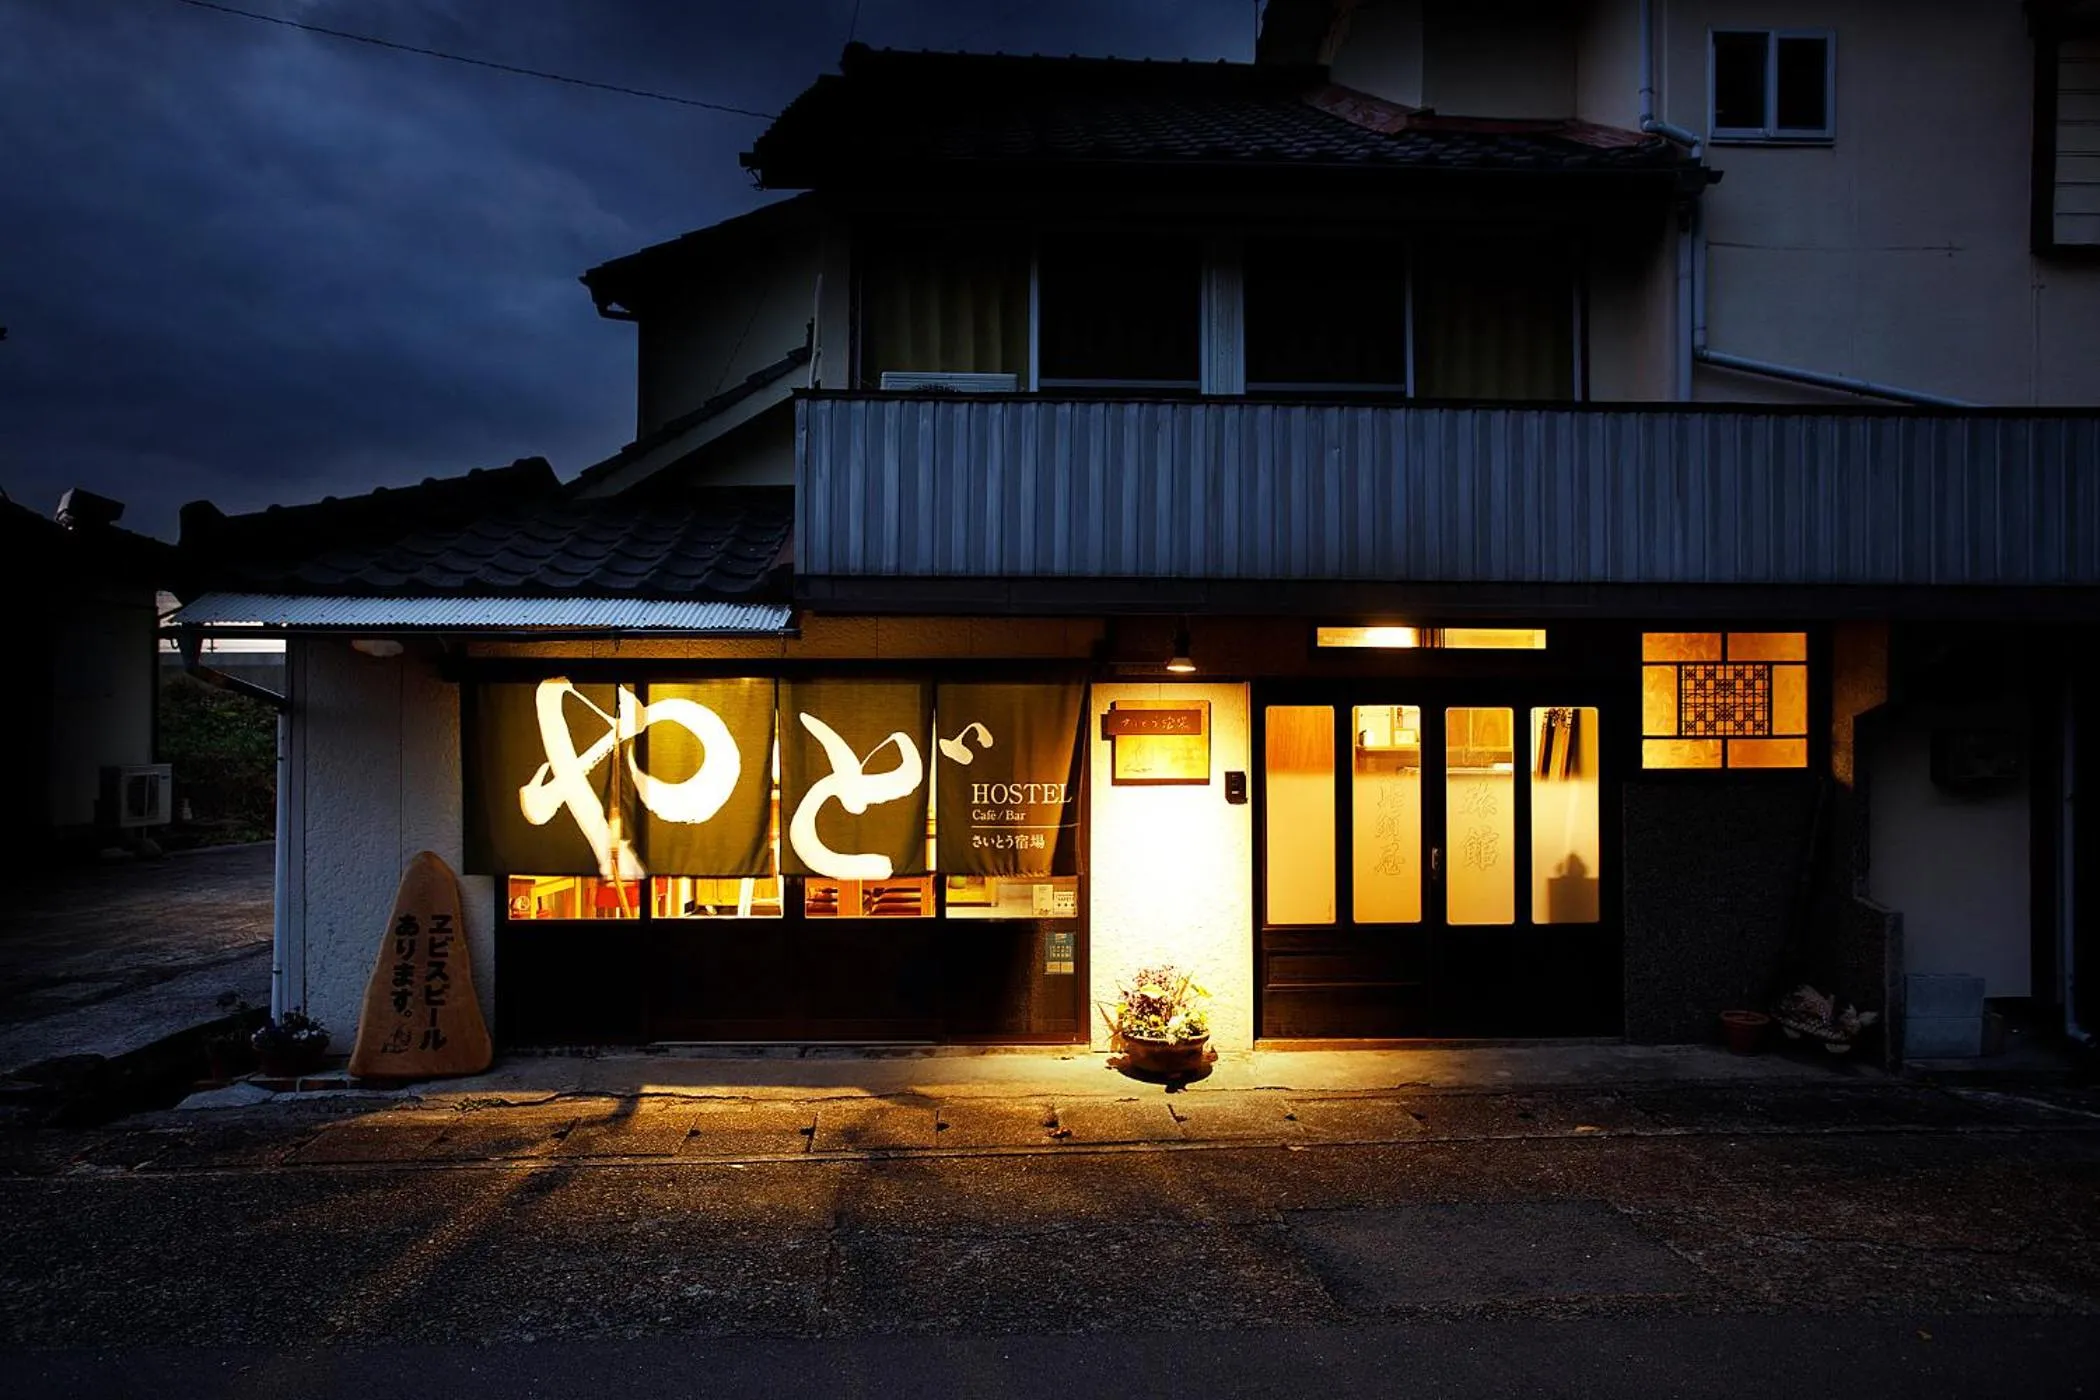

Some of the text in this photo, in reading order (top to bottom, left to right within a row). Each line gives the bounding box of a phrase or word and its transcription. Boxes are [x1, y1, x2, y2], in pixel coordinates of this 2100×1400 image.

[971, 783, 1073, 805] HOSTEL
[972, 834, 1045, 849] さいとう宿場
[390, 913, 419, 1018] あります。
